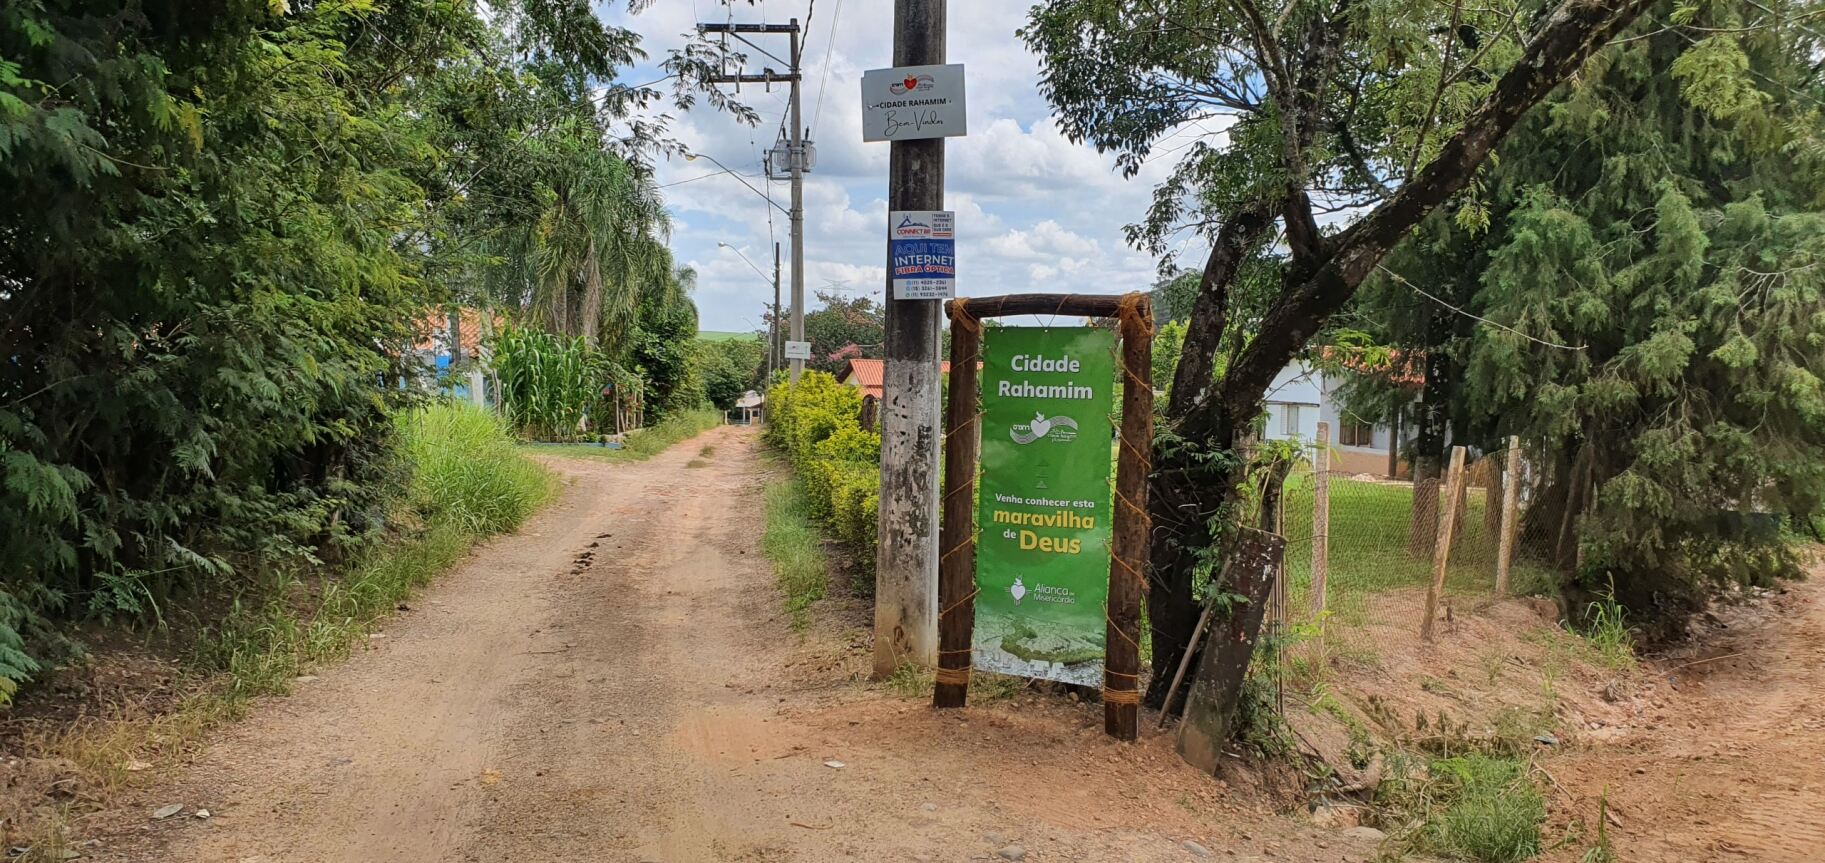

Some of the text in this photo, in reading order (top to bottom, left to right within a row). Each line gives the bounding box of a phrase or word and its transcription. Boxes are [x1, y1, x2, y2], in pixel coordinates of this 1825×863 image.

[879, 98, 947, 109] CIDADE RAHAMIM
[896, 243, 928, 255] AQUI
[895, 255, 955, 267] INTERNET
[895, 263, 955, 275] FIBRA ÓPTICA
[1011, 354, 1080, 373] Cidade
[998, 380, 1093, 400] Rahamim
[995, 493, 1095, 508] Venha conhecer esta
[993, 510, 1095, 529] maravilha
[1003, 529, 1081, 554] de Deus
